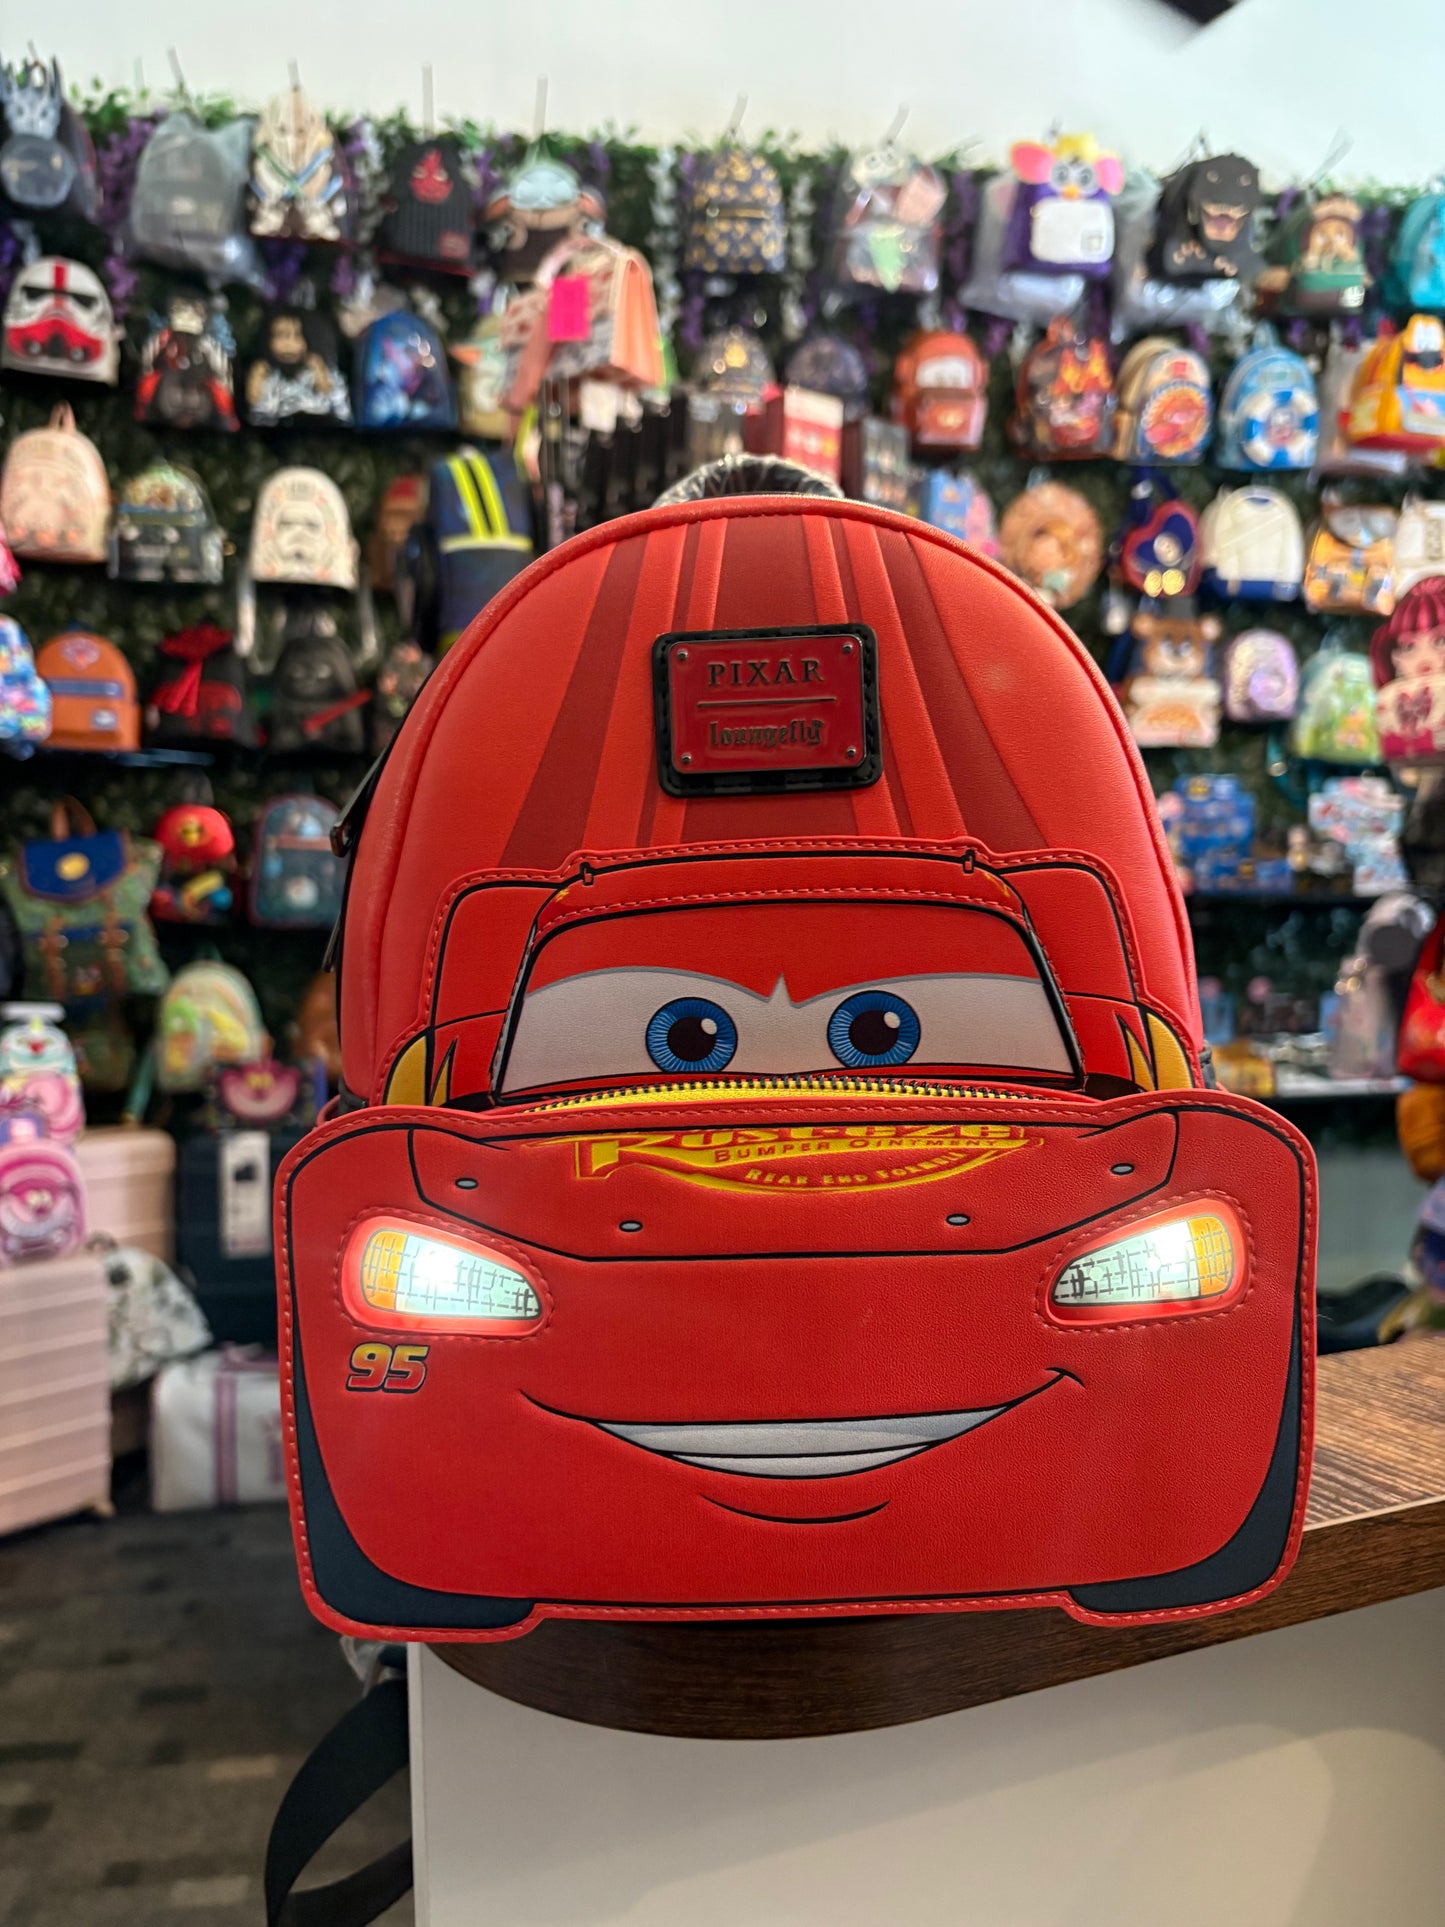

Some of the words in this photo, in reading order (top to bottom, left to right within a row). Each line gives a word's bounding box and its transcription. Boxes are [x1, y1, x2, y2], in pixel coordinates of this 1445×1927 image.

[707, 658, 825, 687] PIXAR
[713, 1141, 830, 1164] BUMPER
[848, 1138, 998, 1149] OINTMENT
[345, 1341, 431, 1395] 95
